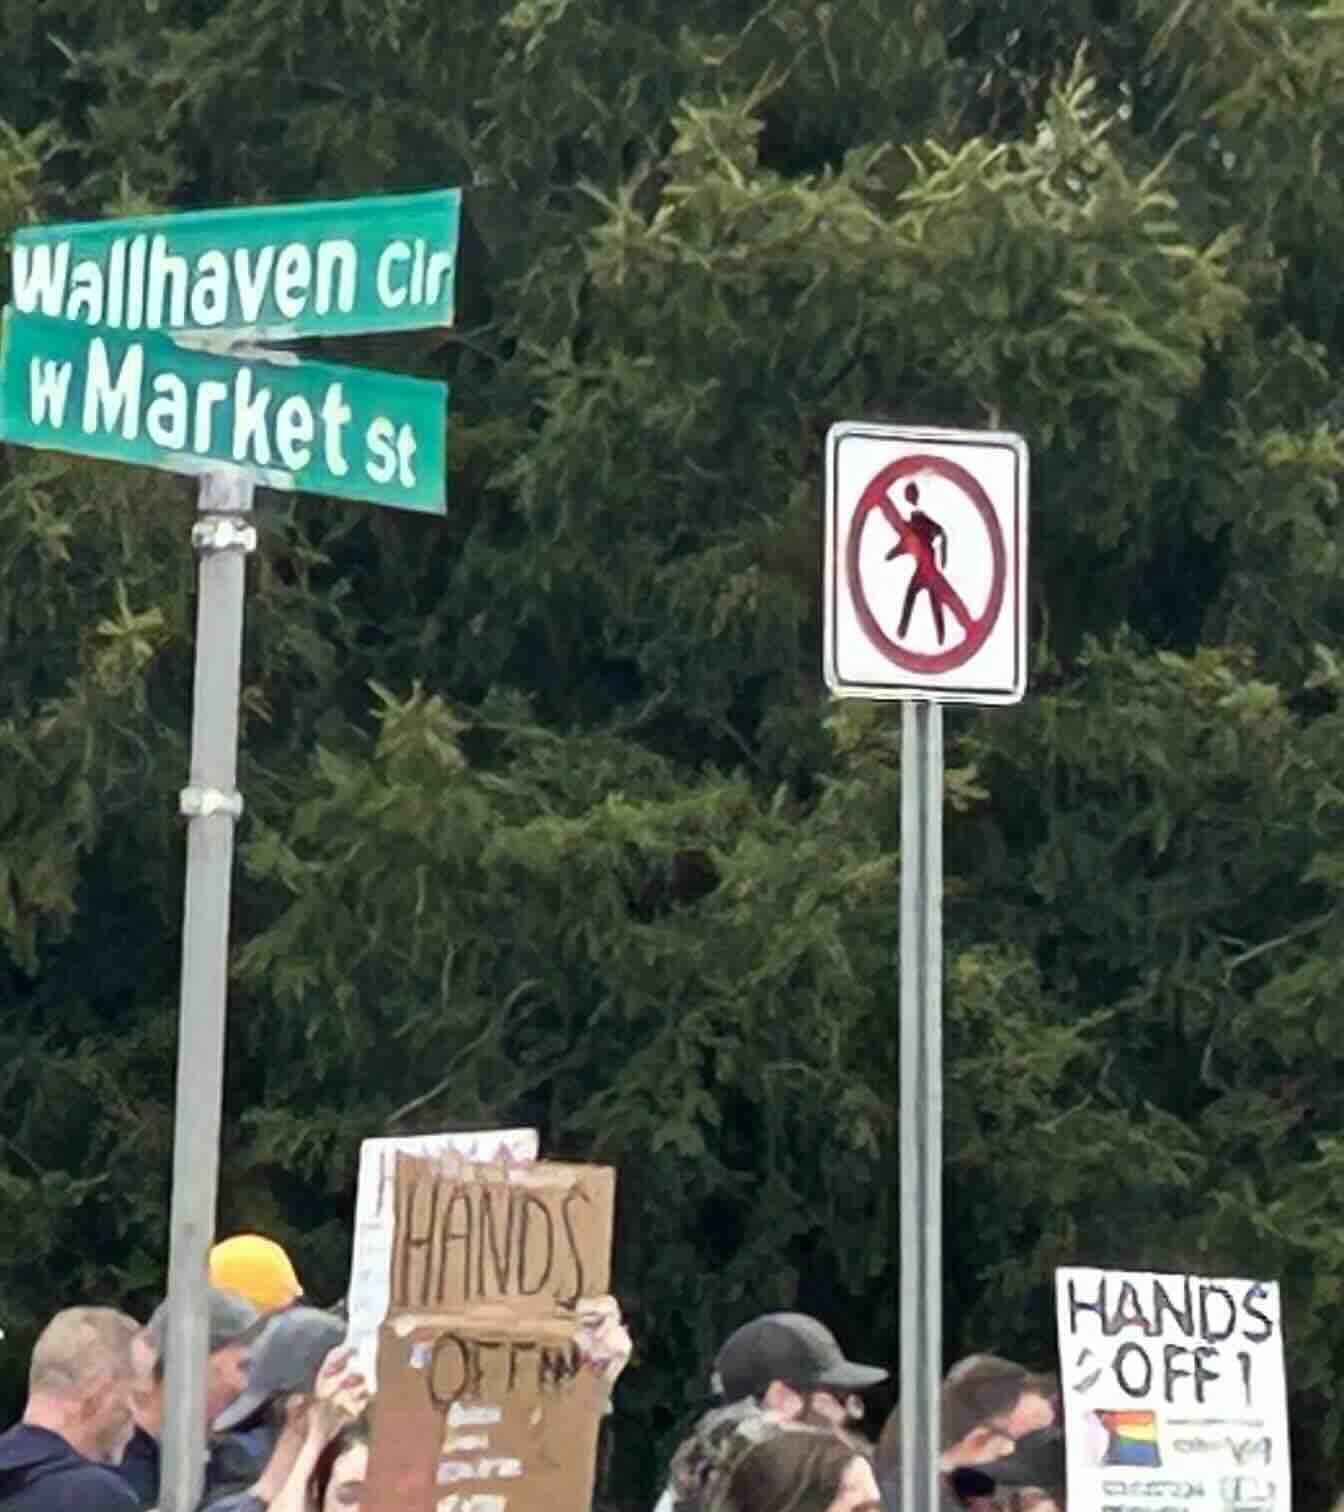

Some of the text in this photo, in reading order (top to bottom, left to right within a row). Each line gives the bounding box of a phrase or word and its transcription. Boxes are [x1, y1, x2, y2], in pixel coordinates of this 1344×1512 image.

[13, 234, 453, 330] Wallhaven Cir
[29, 337, 416, 488] W Market St
[400, 1179, 592, 1312] HANDS
[1067, 1275, 1274, 1344] HANDS
